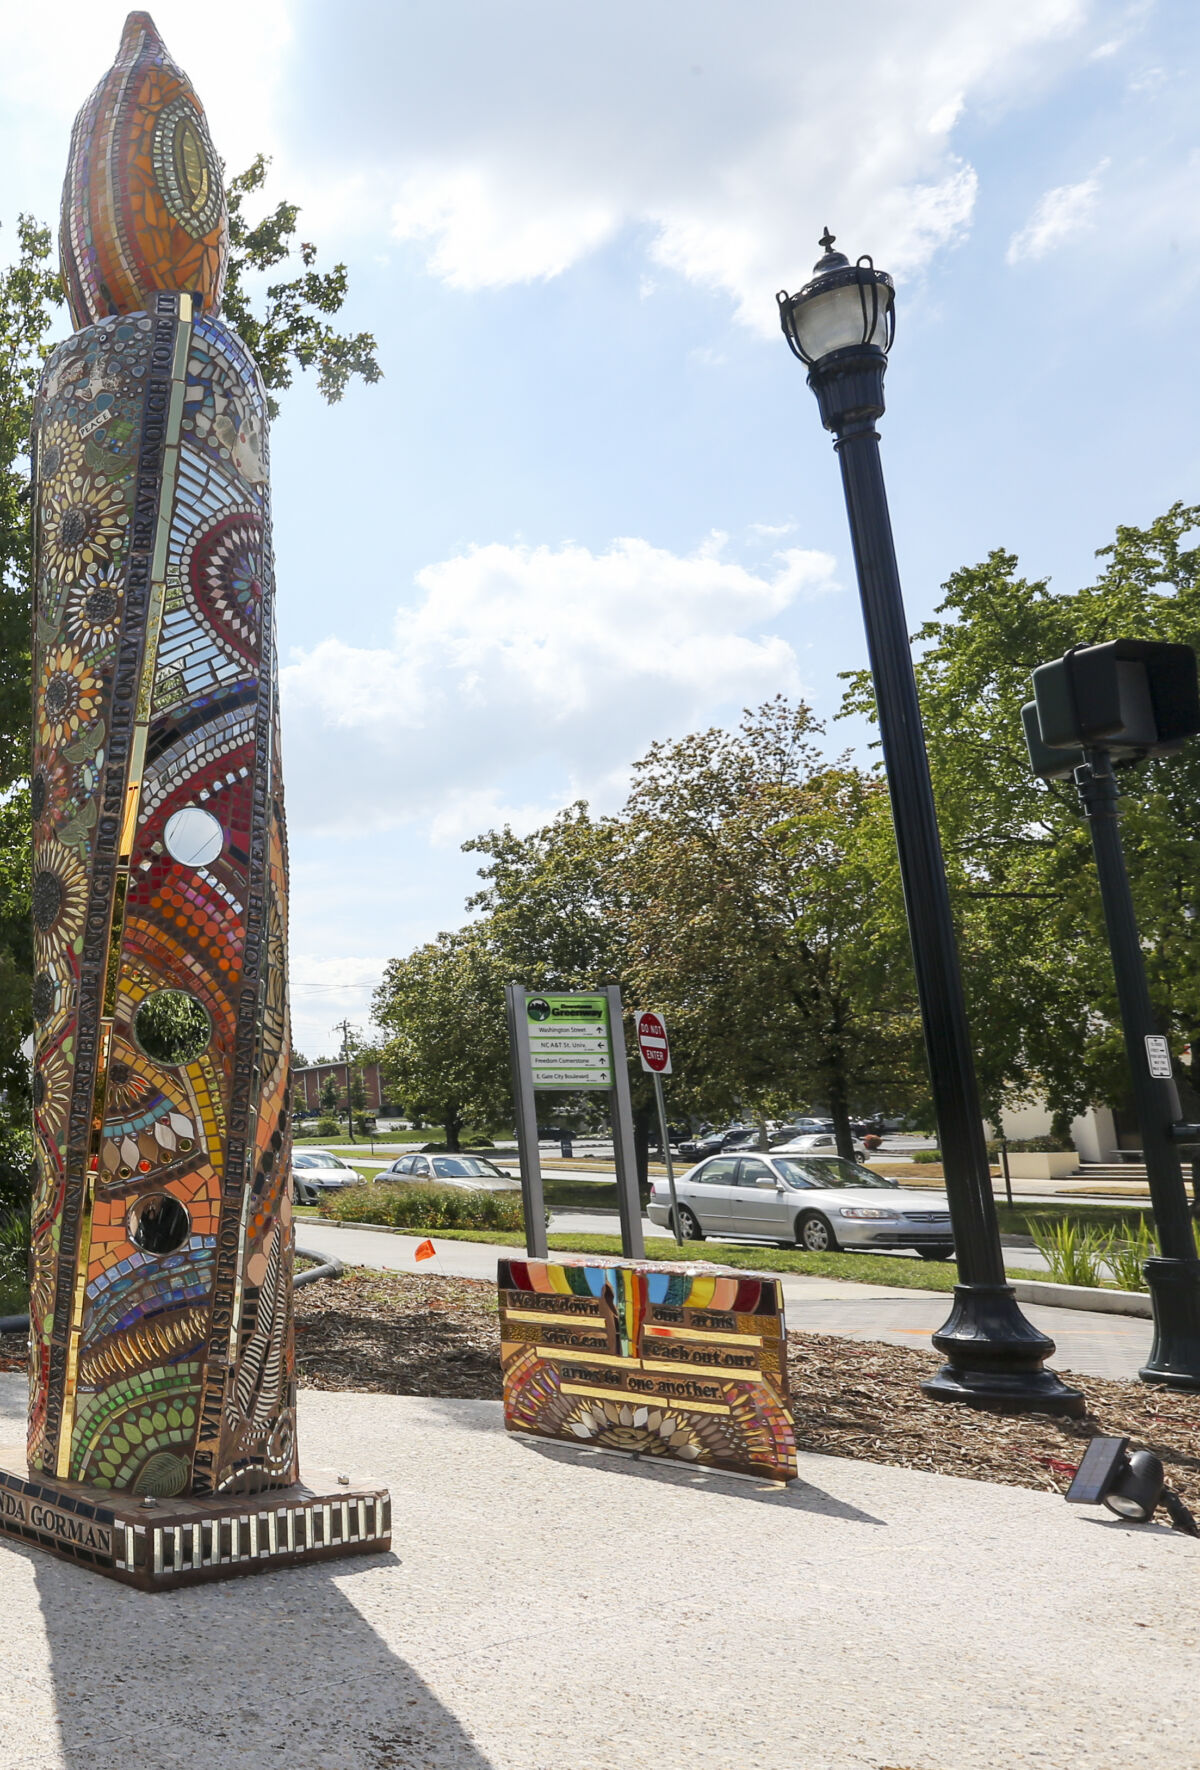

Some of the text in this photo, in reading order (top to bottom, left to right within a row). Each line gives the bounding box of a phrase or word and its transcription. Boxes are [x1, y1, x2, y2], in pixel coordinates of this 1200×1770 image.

[155, 293, 177, 315] IT
[154, 319, 173, 346] BE
[150, 348, 170, 373] TO
[80, 413, 109, 438] PEACE
[139, 379, 168, 473] ENOUGH
[133, 477, 160, 550] BRAVE
[115, 636, 139, 700] ONLY
[111, 704, 129, 729] IF
[108, 737, 126, 762] IT
[102, 767, 122, 814] SEE
[96, 819, 117, 854] TO
[83, 860, 113, 963] ENOUGH
[242, 893, 263, 979] SOUTH
[78, 971, 100, 1055] BRAVE
[538, 1026, 570, 1034] Washington
[552, 1007, 603, 1018] Greenway
[640, 1022, 662, 1035] DO NOT
[235, 988, 256, 1077] BAKED
[646, 1049, 664, 1061] ENTER
[553, 1073, 564, 1081] City
[231, 1080, 249, 1132] SUN
[63, 1148, 85, 1222] ONLY
[224, 1139, 244, 1197] THE
[216, 1205, 240, 1284] FROM
[207, 1289, 232, 1356] RISE
[509, 1292, 532, 1305] We
[559, 1297, 600, 1314] down
[691, 1314, 734, 1328] arms
[581, 1335, 607, 1348] can
[643, 1342, 754, 1366] reach out our
[45, 1346, 66, 1449] ALWAYS
[562, 1367, 600, 1382] arms
[628, 1377, 654, 1391] one
[658, 1380, 723, 1399] another.
[198, 1366, 227, 1442] WILL
[192, 1450, 214, 1494] WE
[31, 1504, 111, 1551] GORMAN
